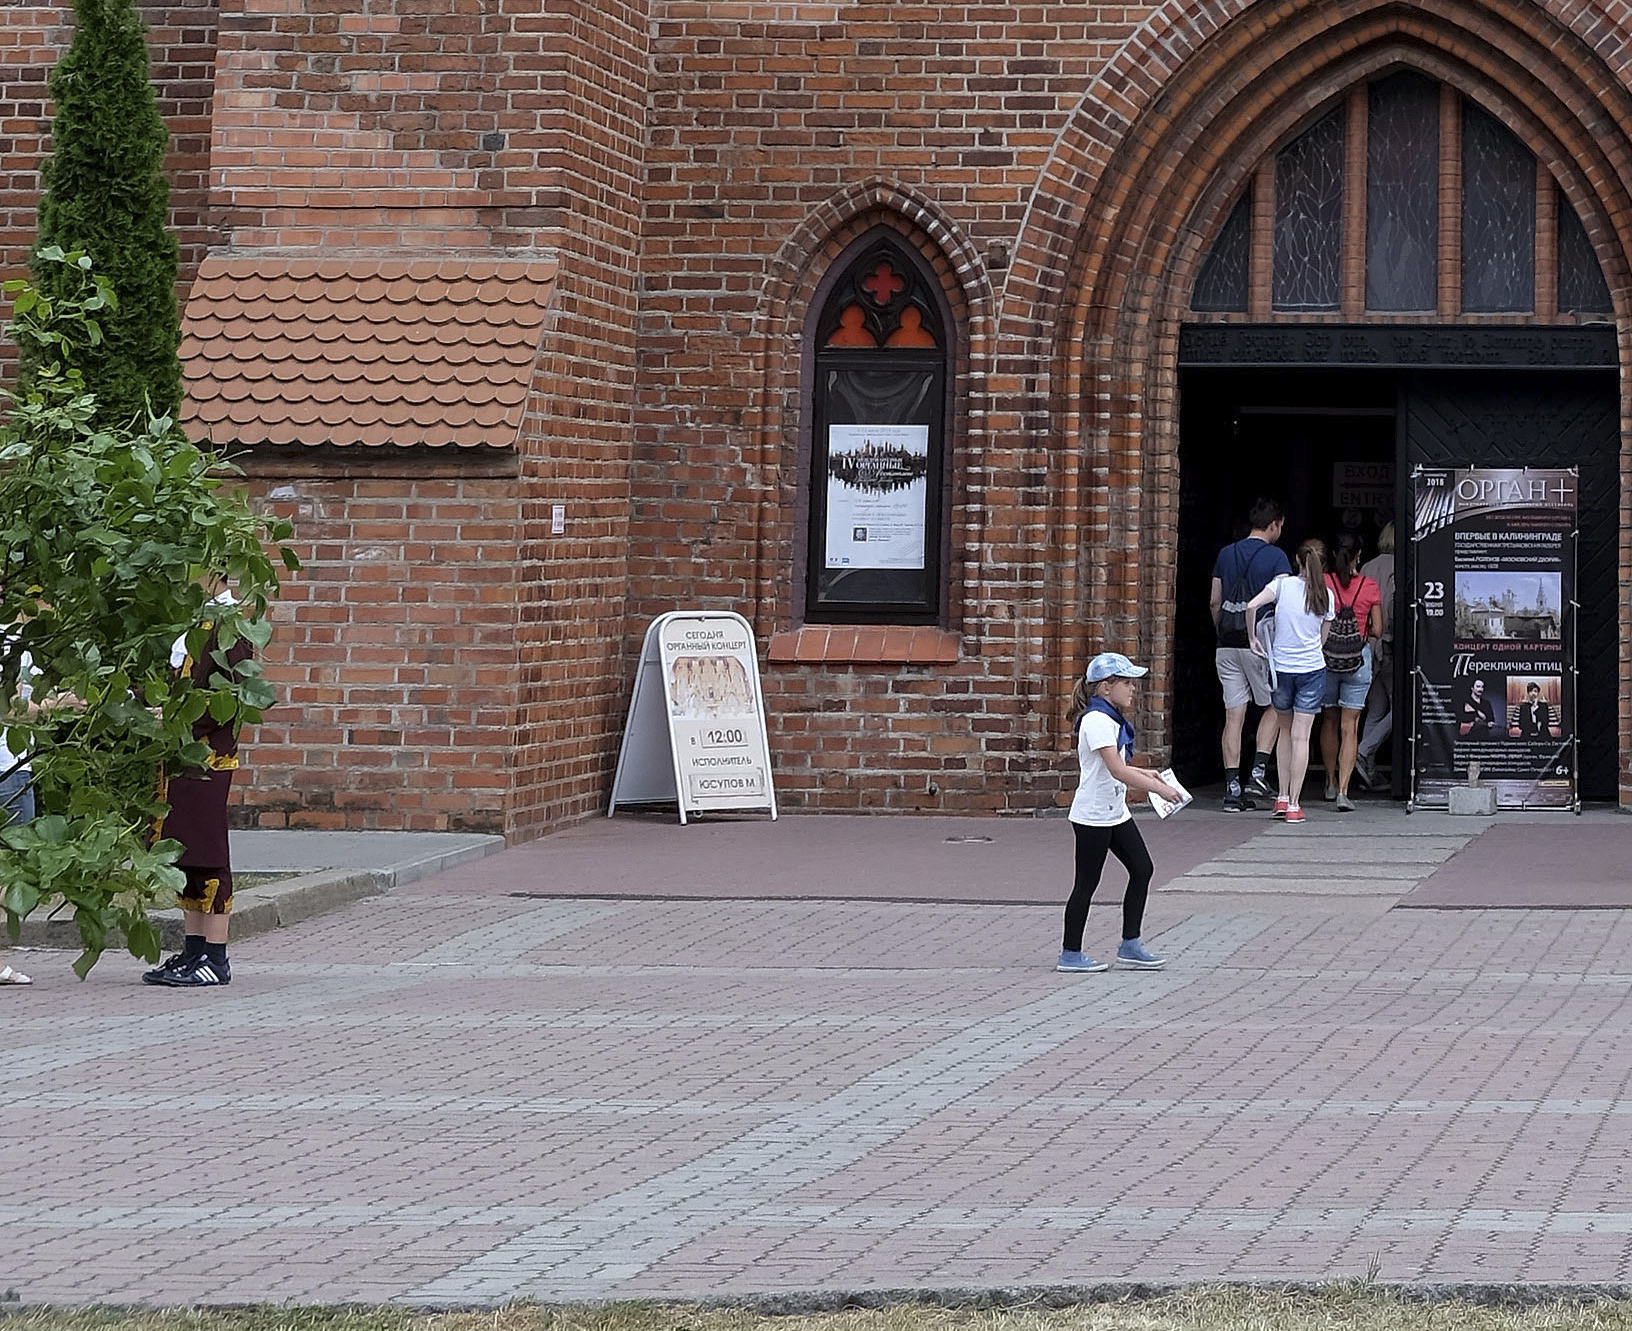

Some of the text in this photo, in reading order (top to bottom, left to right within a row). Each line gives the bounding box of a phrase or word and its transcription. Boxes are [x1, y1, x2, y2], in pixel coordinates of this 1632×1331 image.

[1454, 532, 1491, 540] ВПЕРВЫЕ
[1498, 532, 1562, 541] КАЛИНИНГРАДЕ
[1424, 582, 1445, 599] 23
[685, 630, 724, 640] СЕГОДНЯ
[666, 640, 747, 651] ОРГАННЫЙ КОНЦЕРТ
[1453, 642, 1562, 652] КОНЦЕРТ ОДНОЙ КАРТИНЫ
[1450, 653, 1563, 678] Перекличка птиц
[707, 729, 743, 743] 12:00
[691, 756, 752, 767] ИСПОЛНИТЕЛЬ
[1556, 765, 1569, 775] 6+
[699, 779, 744, 789] ЮСУПОВ
